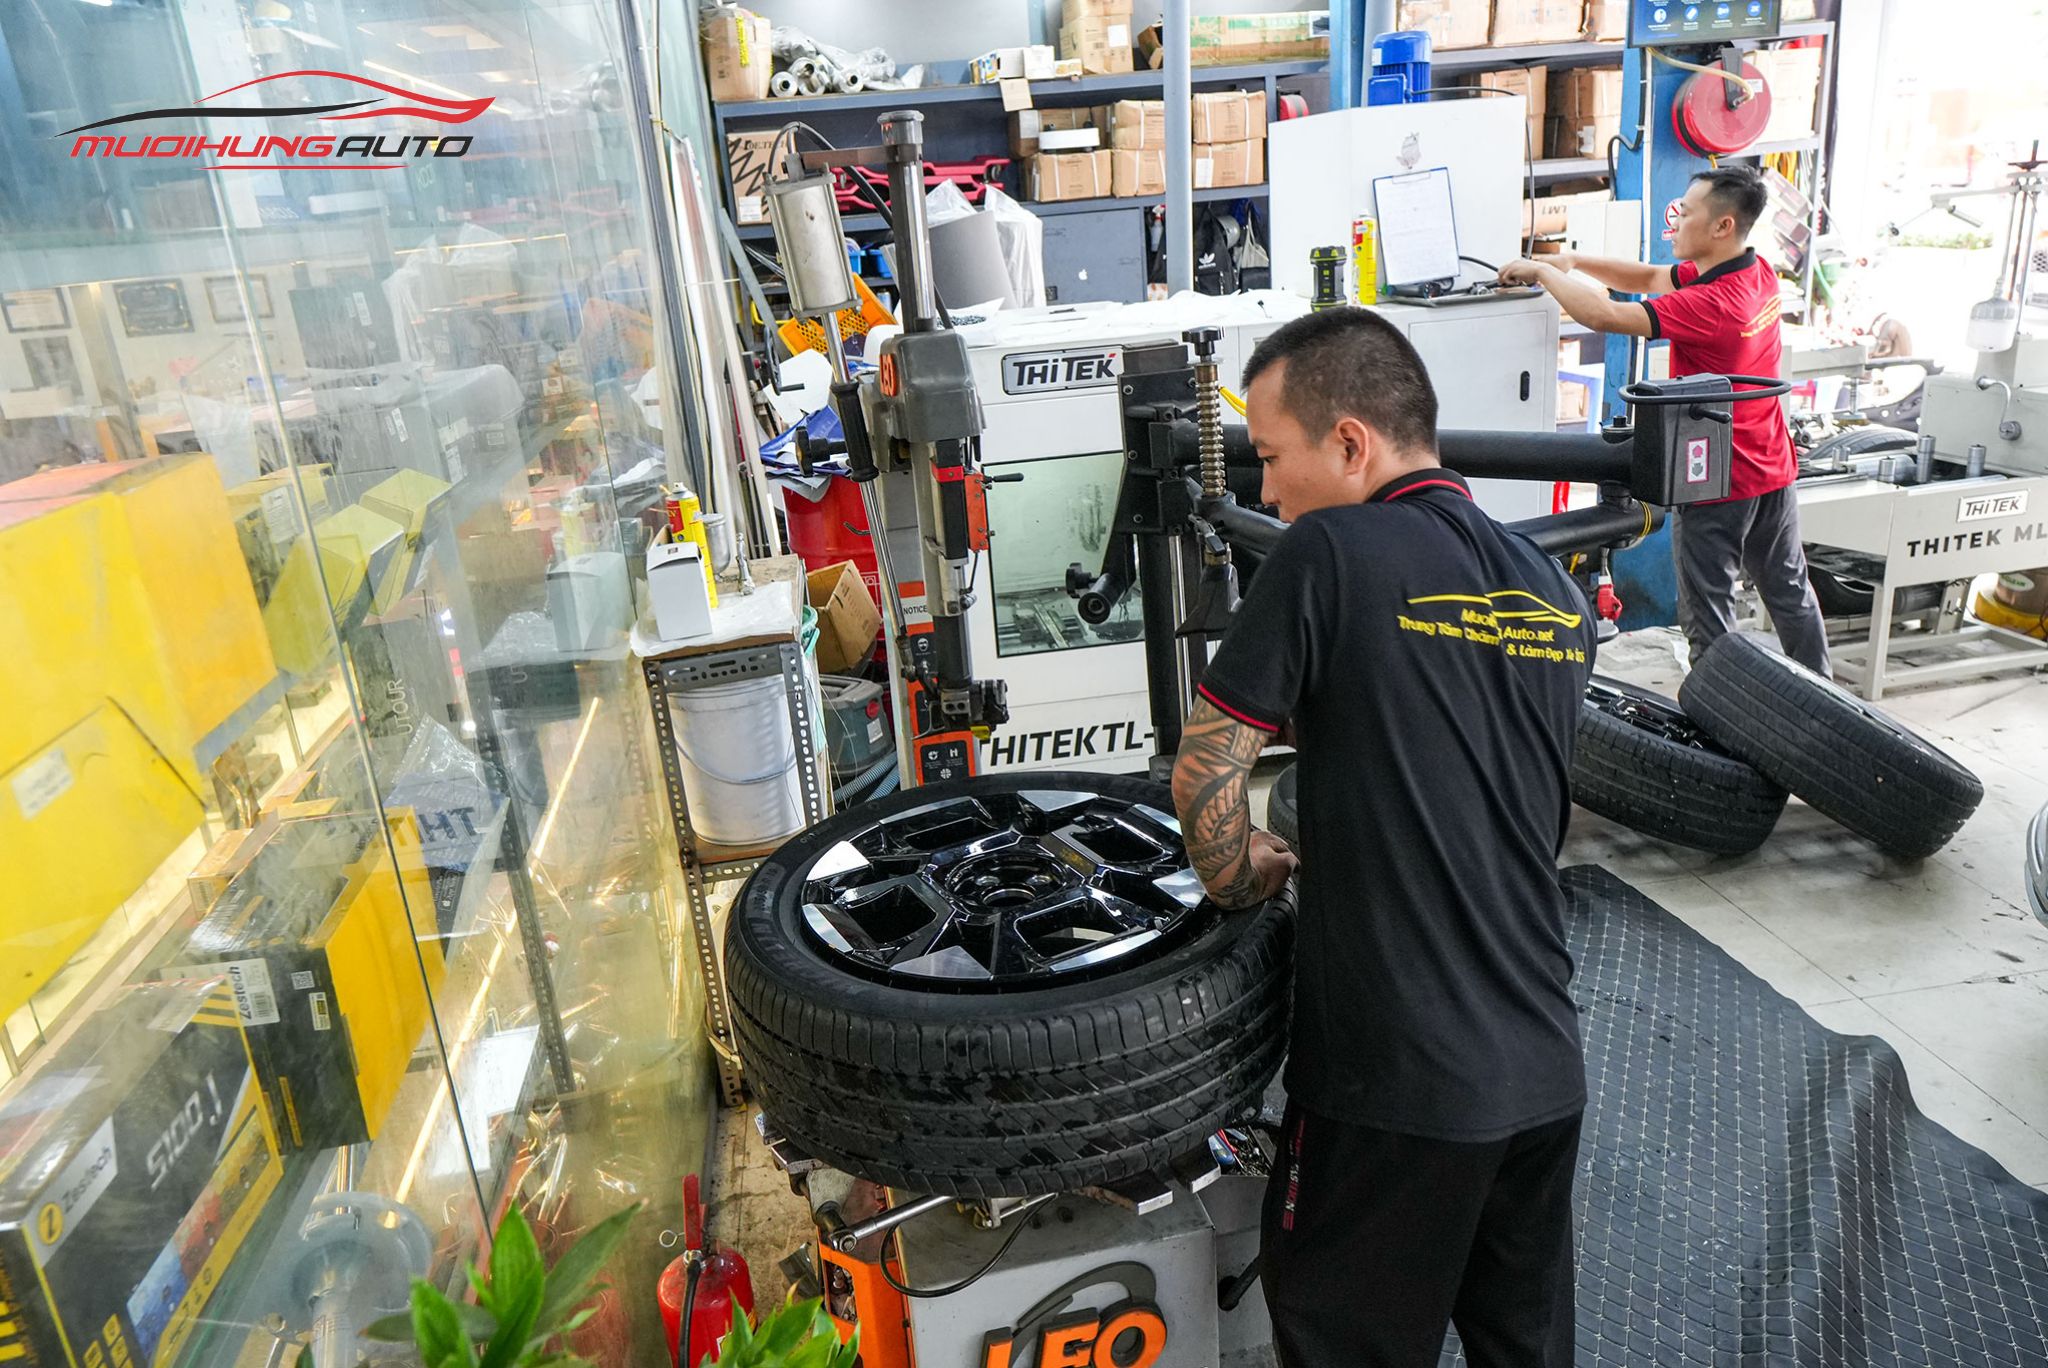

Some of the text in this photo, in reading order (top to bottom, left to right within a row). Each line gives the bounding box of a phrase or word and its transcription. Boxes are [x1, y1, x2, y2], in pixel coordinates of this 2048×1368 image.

[1907, 528, 2003, 558] THITEK
[903, 604, 928, 616] NOTICE
[232, 965, 252, 1020] Zestech
